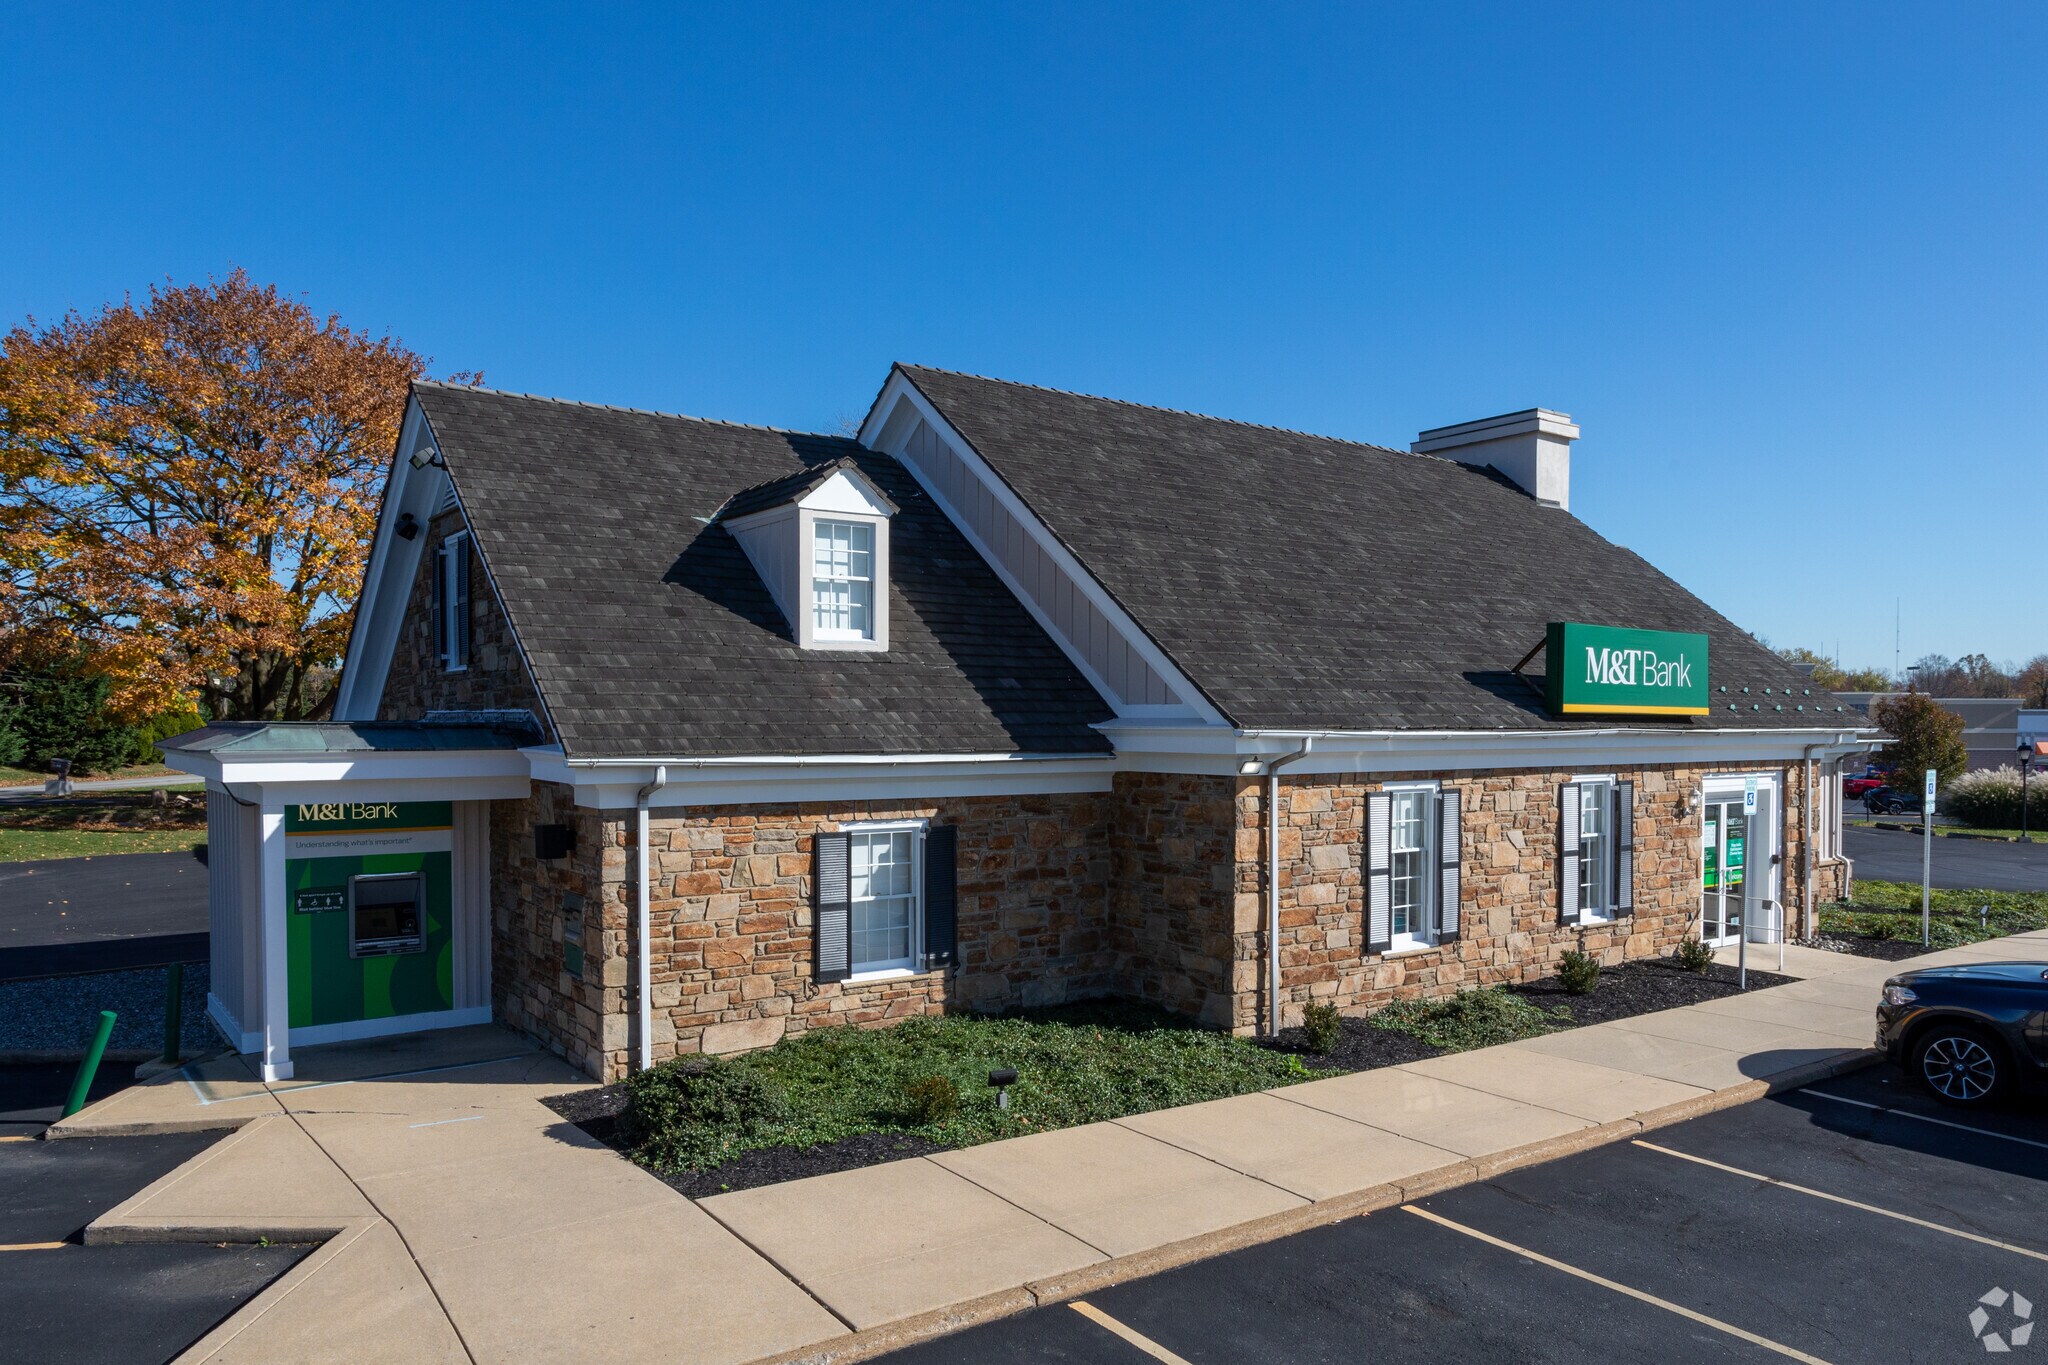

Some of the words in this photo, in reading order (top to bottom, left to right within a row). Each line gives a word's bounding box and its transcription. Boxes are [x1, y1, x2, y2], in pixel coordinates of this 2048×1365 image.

[1585, 647, 1642, 685] M&T
[1643, 651, 1692, 688] Bank
[298, 803, 349, 822] M&T
[352, 802, 398, 820] Bank
[295, 841, 350, 849] Understanding
[350, 839, 374, 847] what's
